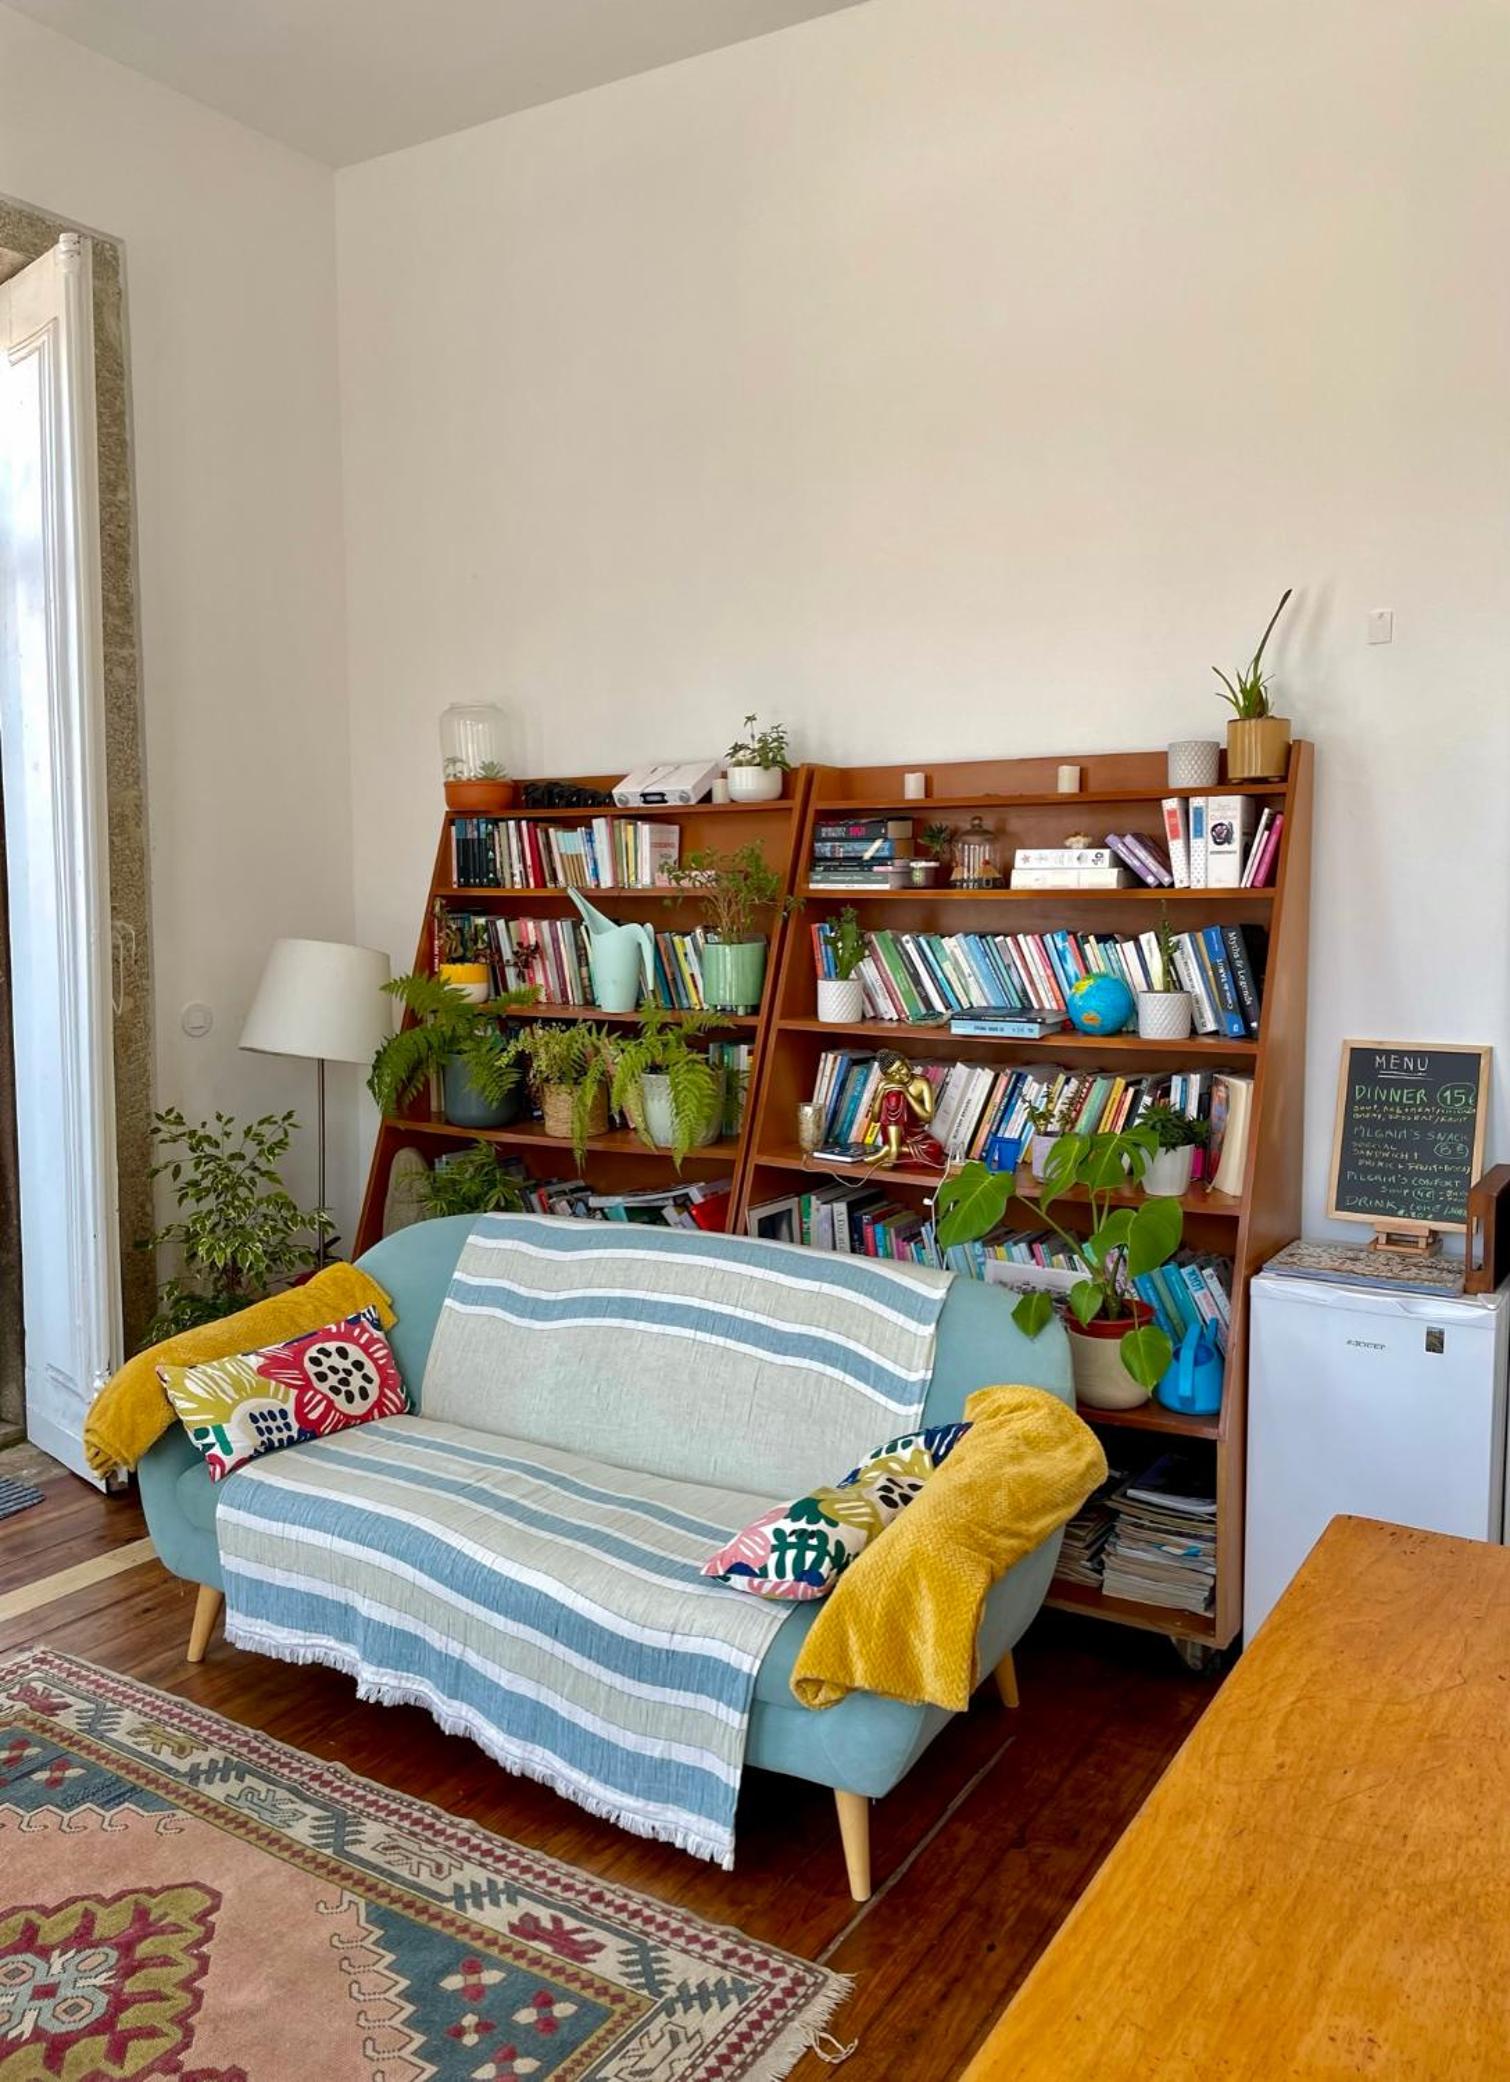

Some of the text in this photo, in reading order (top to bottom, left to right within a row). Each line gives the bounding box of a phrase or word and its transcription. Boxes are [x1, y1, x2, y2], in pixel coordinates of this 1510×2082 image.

[1228, 931, 1240, 958] Myths
[1237, 969, 1253, 1006] Legends
[1374, 1054, 1429, 1071] MENU
[1355, 1085, 1428, 1105] DINNER
[1345, 1195, 1398, 1210] DRINK
